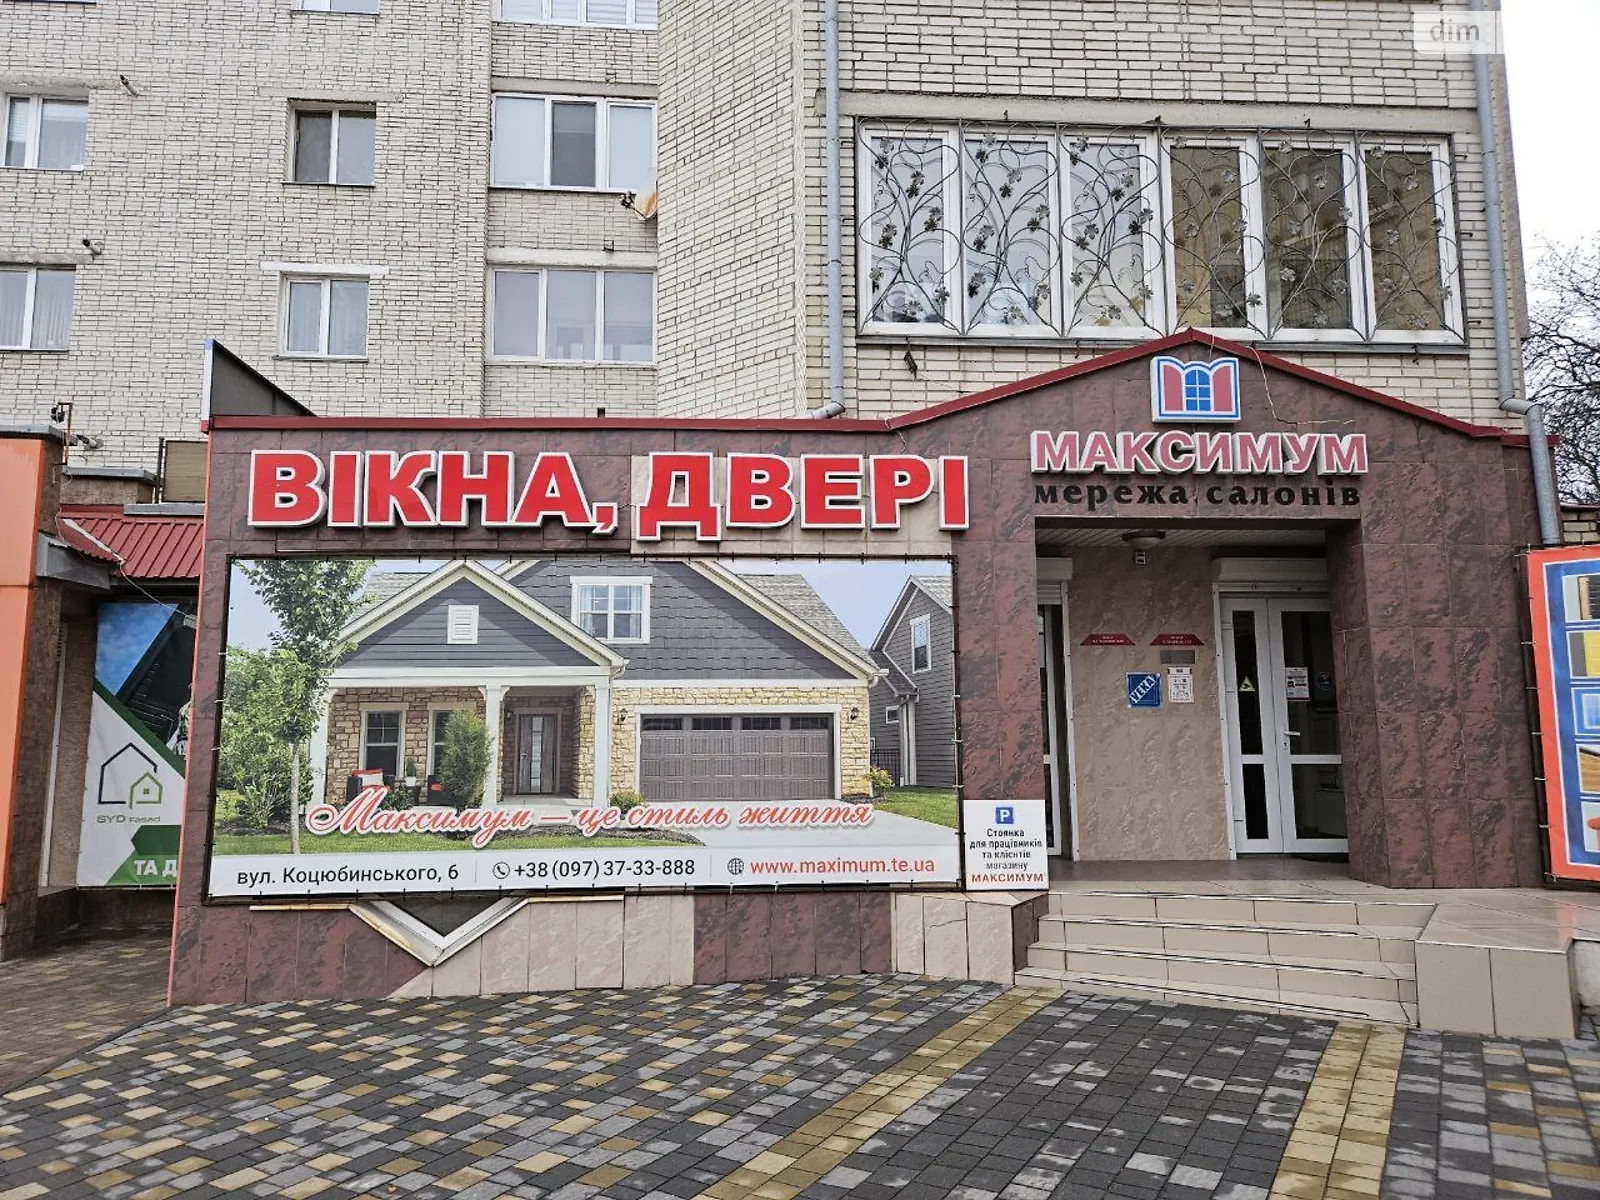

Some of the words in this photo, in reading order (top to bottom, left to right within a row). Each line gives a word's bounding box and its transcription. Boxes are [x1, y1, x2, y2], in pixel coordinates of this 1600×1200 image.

[1031, 430, 1368, 475] МАКСИМУМ
[248, 449, 618, 534] ВІКНА,
[635, 452, 970, 541] ДВЕРІ
[1035, 484, 1188, 511] мережа
[1206, 479, 1359, 506] салонів
[1129, 675, 1157, 703] VEKA
[96, 815, 126, 824] SYD
[306, 786, 532, 848] Максимум
[574, 805, 622, 836] це
[627, 803, 731, 828] стиль
[738, 802, 874, 828] життя
[1000, 809, 1011, 822] P
[986, 828, 1025, 837] Стоянка
[969, 840, 987, 850] для
[989, 838, 1042, 849] працівників
[994, 850, 1031, 859] клієнтів
[134, 859, 158, 876] ТА
[237, 870, 276, 885] вул.
[282, 864, 443, 886] Коцюбинського,
[447, 864, 459, 880] 6
[513, 861, 549, 878] +38
[603, 859, 696, 877] 37-33-888
[750, 858, 936, 875] www.maximum.te.ua
[986, 862, 1028, 871] магазину
[971, 873, 1044, 882] МАКСИМУМ
